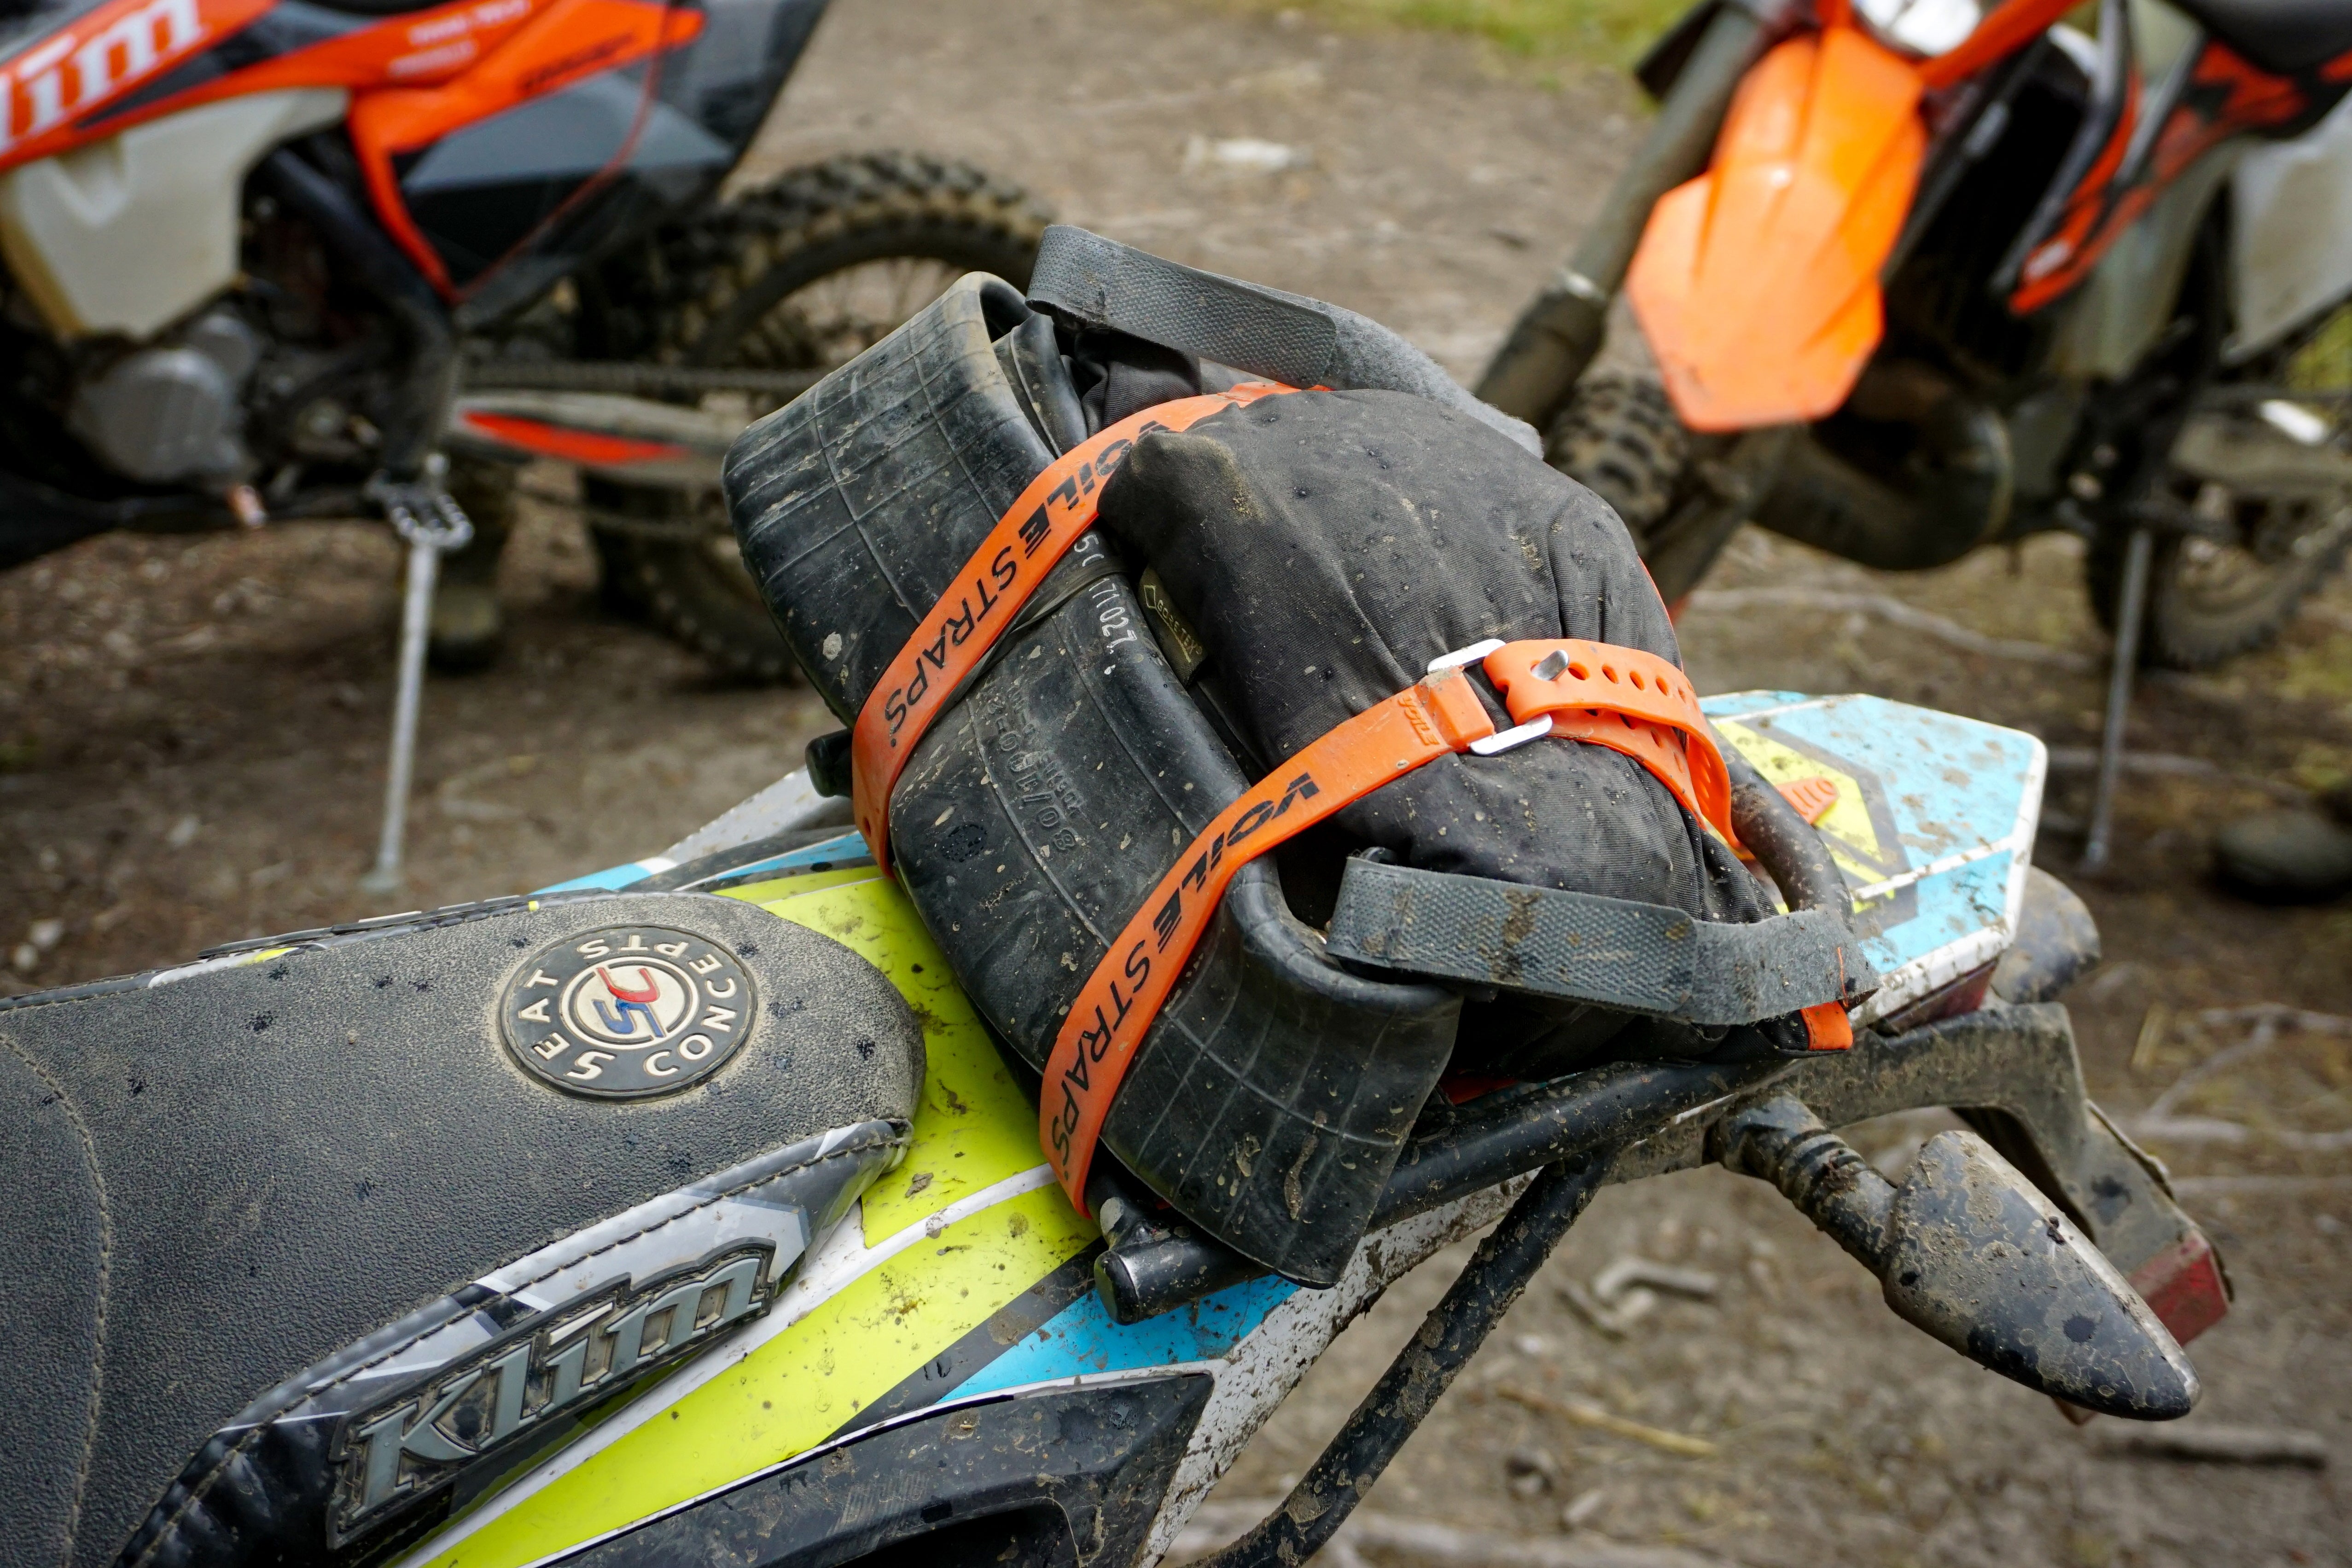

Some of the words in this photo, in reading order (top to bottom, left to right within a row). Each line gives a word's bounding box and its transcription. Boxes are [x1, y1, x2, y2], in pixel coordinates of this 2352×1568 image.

[1153, 772, 1320, 953] VOILE
[518, 969, 616, 1080] SEAT
[577, 935, 737, 1076] CONCEPTS
